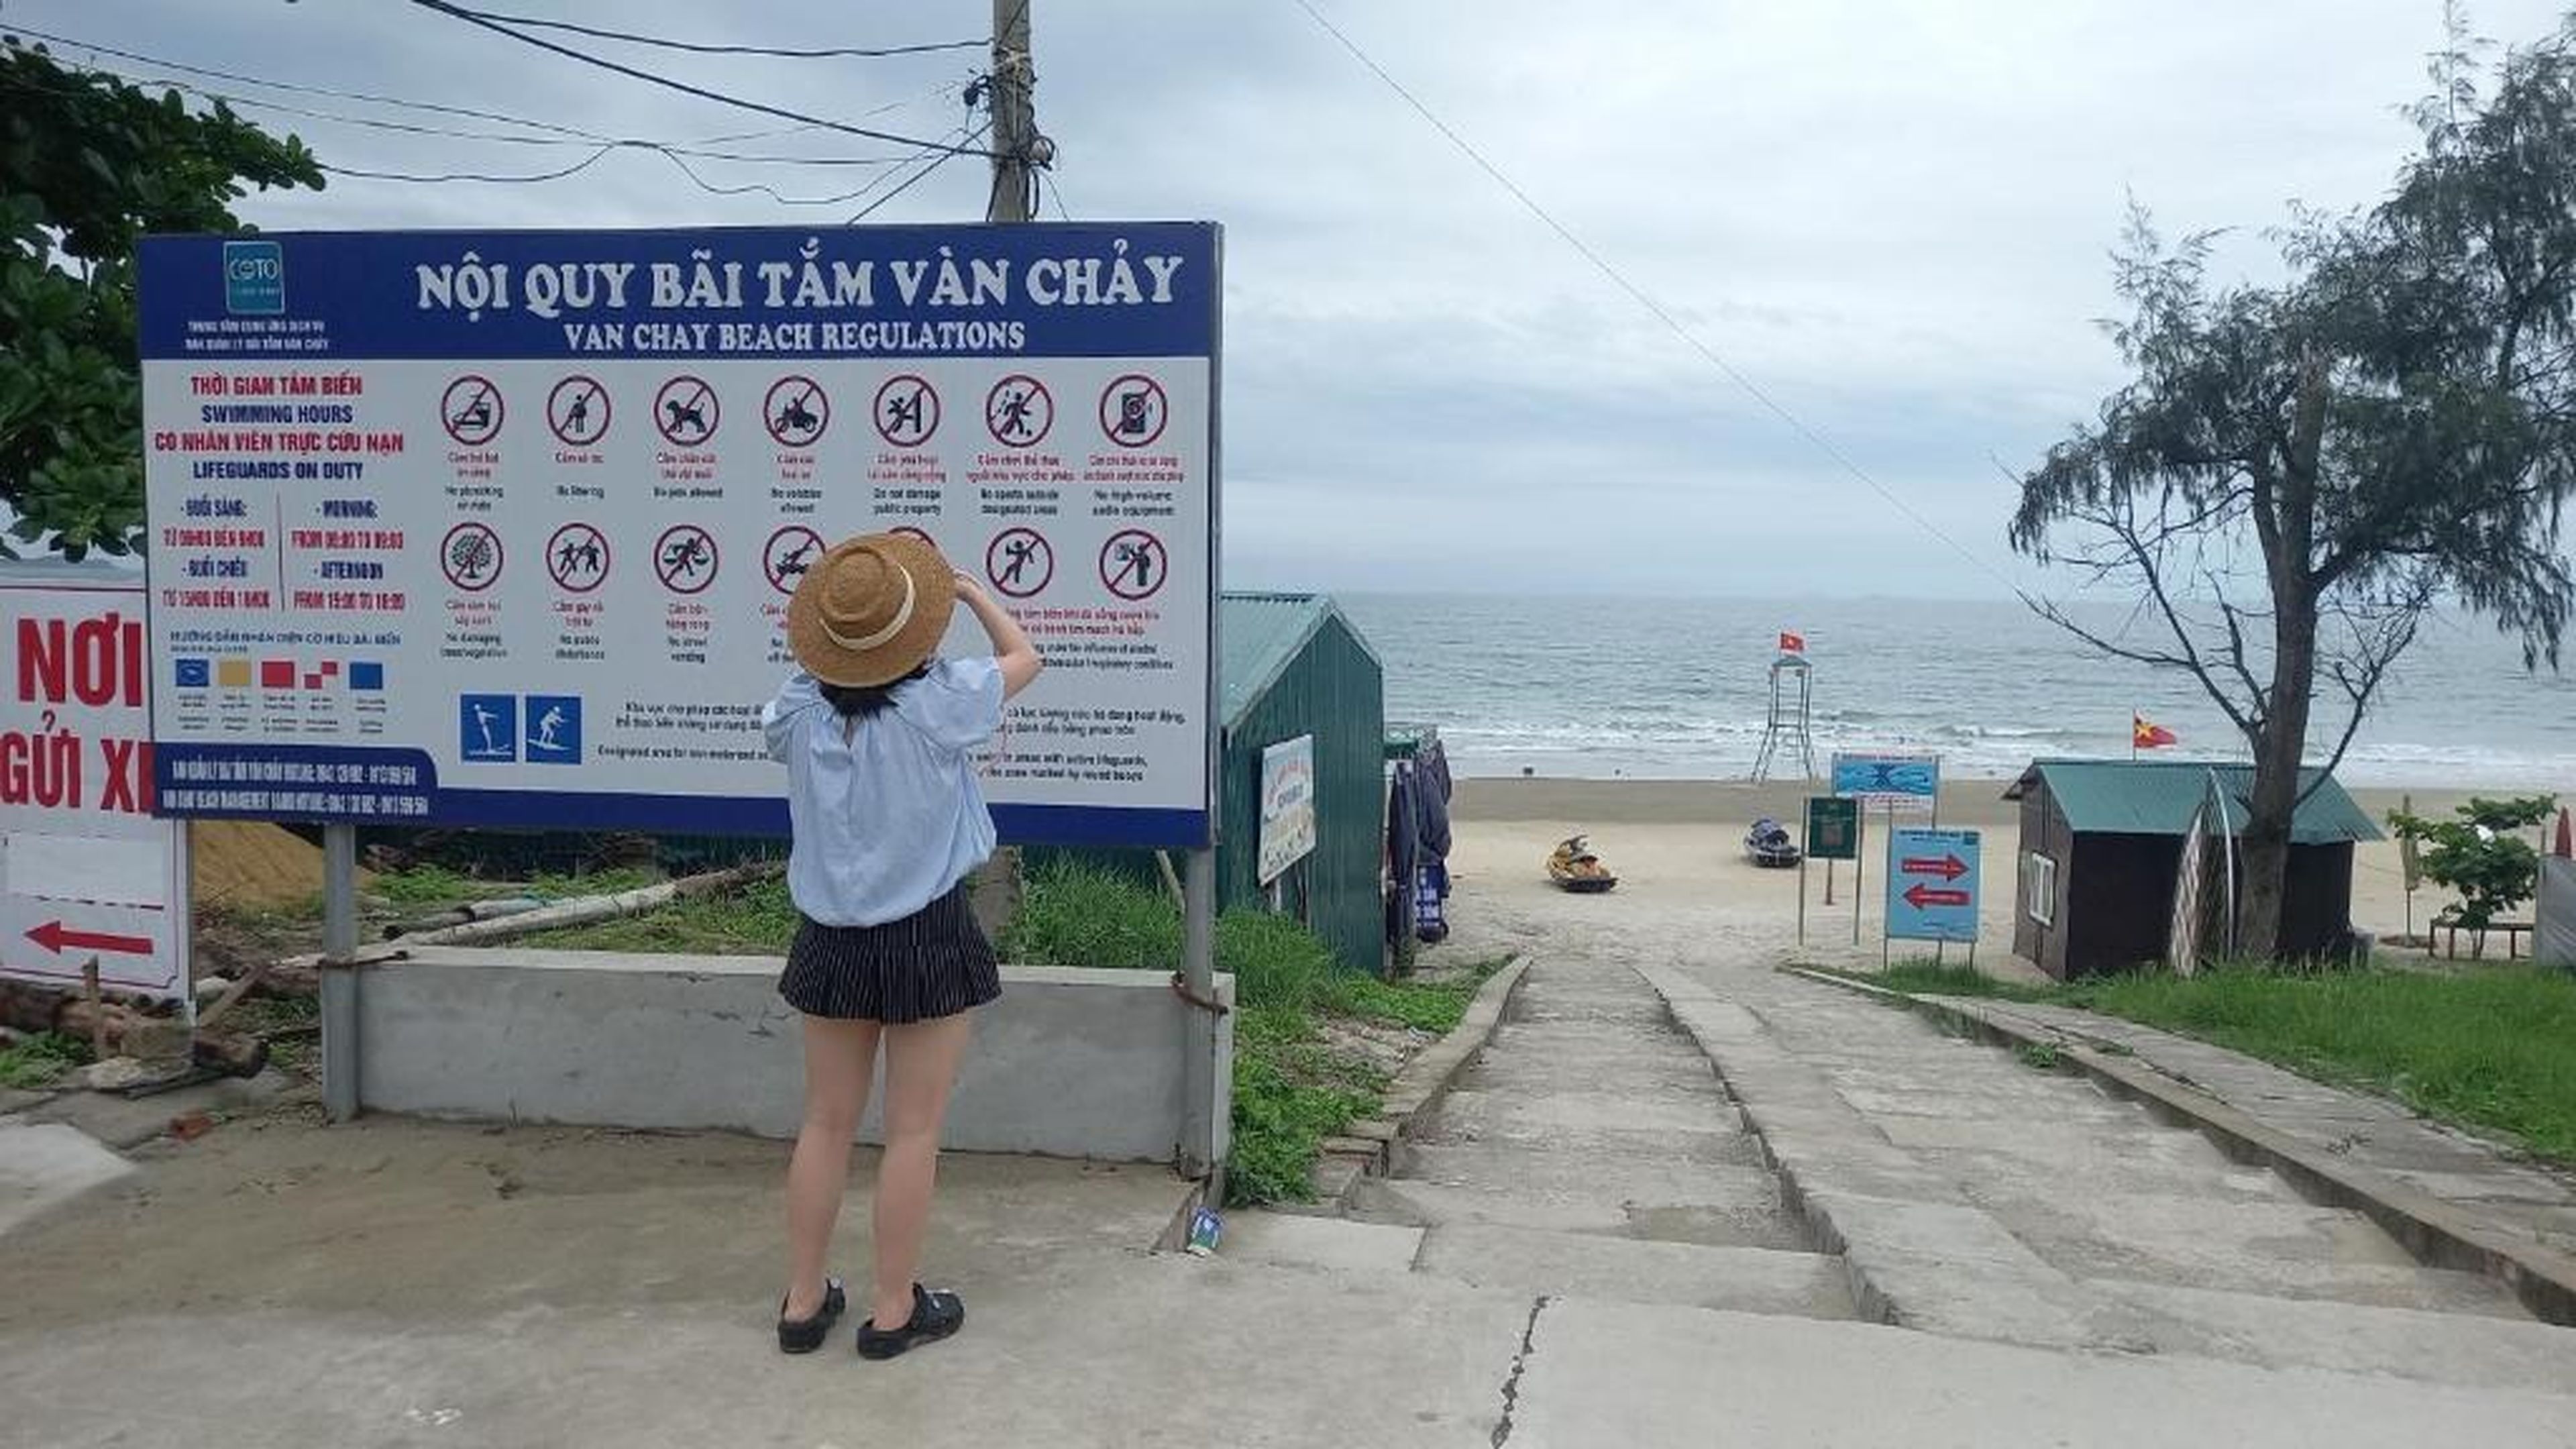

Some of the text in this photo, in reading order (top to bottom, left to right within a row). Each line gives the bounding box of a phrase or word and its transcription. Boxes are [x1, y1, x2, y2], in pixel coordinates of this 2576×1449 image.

[416, 237, 1185, 323] NỘI QUY BÃI TẮM VÀN CHẢY
[564, 321, 1025, 351] VAN CHAY BEACH REGULATIONS
[234, 377, 274, 395] GIAN
[202, 405, 353, 423] SWIMMING HOURS
[193, 462, 363, 480] LIFEGUARDS ON DUTY
[17, 612, 143, 707] NƠI
[0, 710, 82, 809] GỬI
